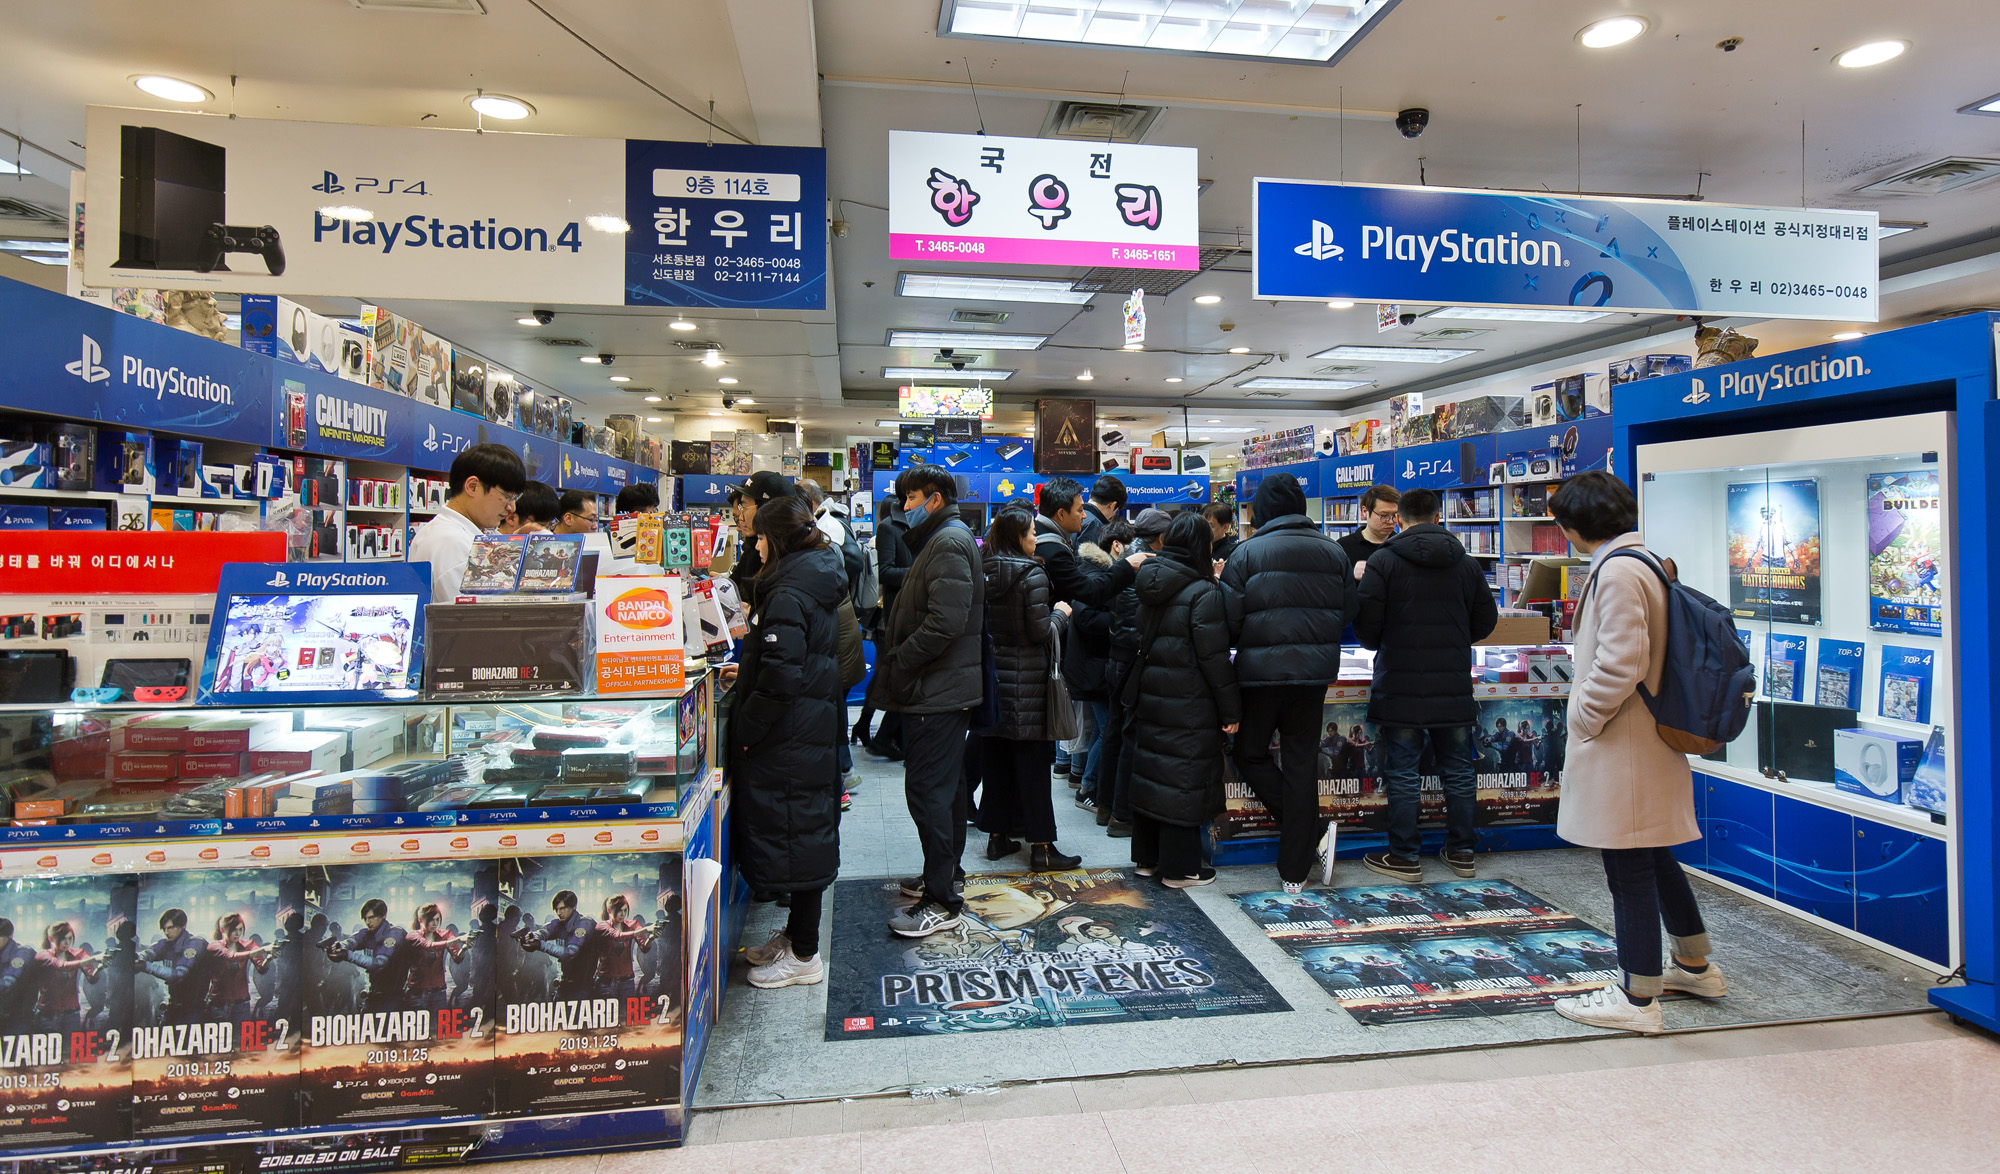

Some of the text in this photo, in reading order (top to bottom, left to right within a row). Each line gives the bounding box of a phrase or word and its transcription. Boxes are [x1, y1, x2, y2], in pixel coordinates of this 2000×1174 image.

[980, 146, 1112, 179] 국 전
[355, 177, 429, 196] PS4
[686, 176, 770, 196] 9층 114호
[927, 167, 1162, 230] 한 우 리
[1667, 215, 1868, 241] 플레이스테이션 공식지정대리점
[915, 240, 985, 254] T. 3465-0048
[1112, 248, 1176, 261] F. 3465-1651
[1362, 225, 1562, 273] PlayStation
[652, 254, 801, 270] 서초동본점 02-3465-0048
[652, 268, 801, 284] 신도림점 02-2111-7144
[1770, 282, 1868, 299] 02)3465-0048
[122, 354, 232, 406] PlayStation
[1720, 355, 1864, 401] PlayStation
[315, 393, 350, 426] CALL
[353, 402, 388, 437] DUTY
[319, 426, 385, 448] INFINITE WARFARE
[441, 433, 471, 453] PS4
[1336, 464, 1375, 483] CALL DUTY
[1419, 458, 1453, 476] PS4
[1354, 480, 1373, 488] WARFARE
[50, 555, 81, 569] 바꿔
[91, 555, 175, 569] 어디에서나
[296, 572, 387, 590] PlayStation
[525, 569, 558, 578] BIOHAZARD
[617, 601, 665, 611] BANDAI
[1891, 596, 1915, 605] 2019년
[1917, 596, 1930, 605] 1월
[617, 610, 666, 621] NAMCO
[604, 633, 676, 643] Entertainment
[1783, 641, 1805, 650] TOP. 2
[1838, 647, 1863, 658] TOP. 3
[601, 657, 629, 665] 반다이남코
[1904, 655, 1931, 666] TOP. 4
[472, 666, 539, 681] BIOHAZARD RE:2
[601, 663, 681, 679] 공식 파트너 매장
[1363, 777, 1383, 794] RE:2
[1477, 771, 1550, 789] BIOHAZARD RE:2
[1333, 797, 1359, 806] 2019.1.25
[1500, 790, 1527, 798] 2019.1.25
[1366, 914, 1434, 926] BIOHAZARD
[1466, 907, 1533, 919] BIOHAZARD
[1264, 920, 1333, 932] BIOHAZARD
[923, 958, 984, 967] DETECTIVE
[881, 957, 1215, 1006] PRISM OF EYES
[1454, 976, 1533, 991] BIOHAZARD
[1334, 984, 1414, 1000] BIOHAZARD
[506, 994, 670, 1034] BIOHAZARD RE:2
[906, 1015, 970, 1025] PS4
[311, 1007, 483, 1047] BIOHAZARD RE:2
[240, 1018, 289, 1052] RE:2
[560, 1034, 618, 1051] 2019.1.25
[70, 1029, 120, 1063] RE:2
[368, 1048, 429, 1065] 2019.1.25
[628, 1059, 649, 1067] STEAM
[167, 1061, 231, 1078] 2019.1.25
[439, 1074, 461, 1082] STEAM
[554, 1074, 624, 1086] CAPCOM GamePia
[144, 1088, 265, 1102] PS4 STEAM
[361, 1088, 435, 1100] CAPCOM GamePia
[71, 1100, 96, 1108] STEAM
[160, 1103, 238, 1115] CAPCOM GamePia
[30, 1116, 67, 1125] GamePia
[259, 1152, 336, 1169] 2018.08.30
[339, 1149, 360, 1162] ON
[361, 1145, 402, 1160] SALE
